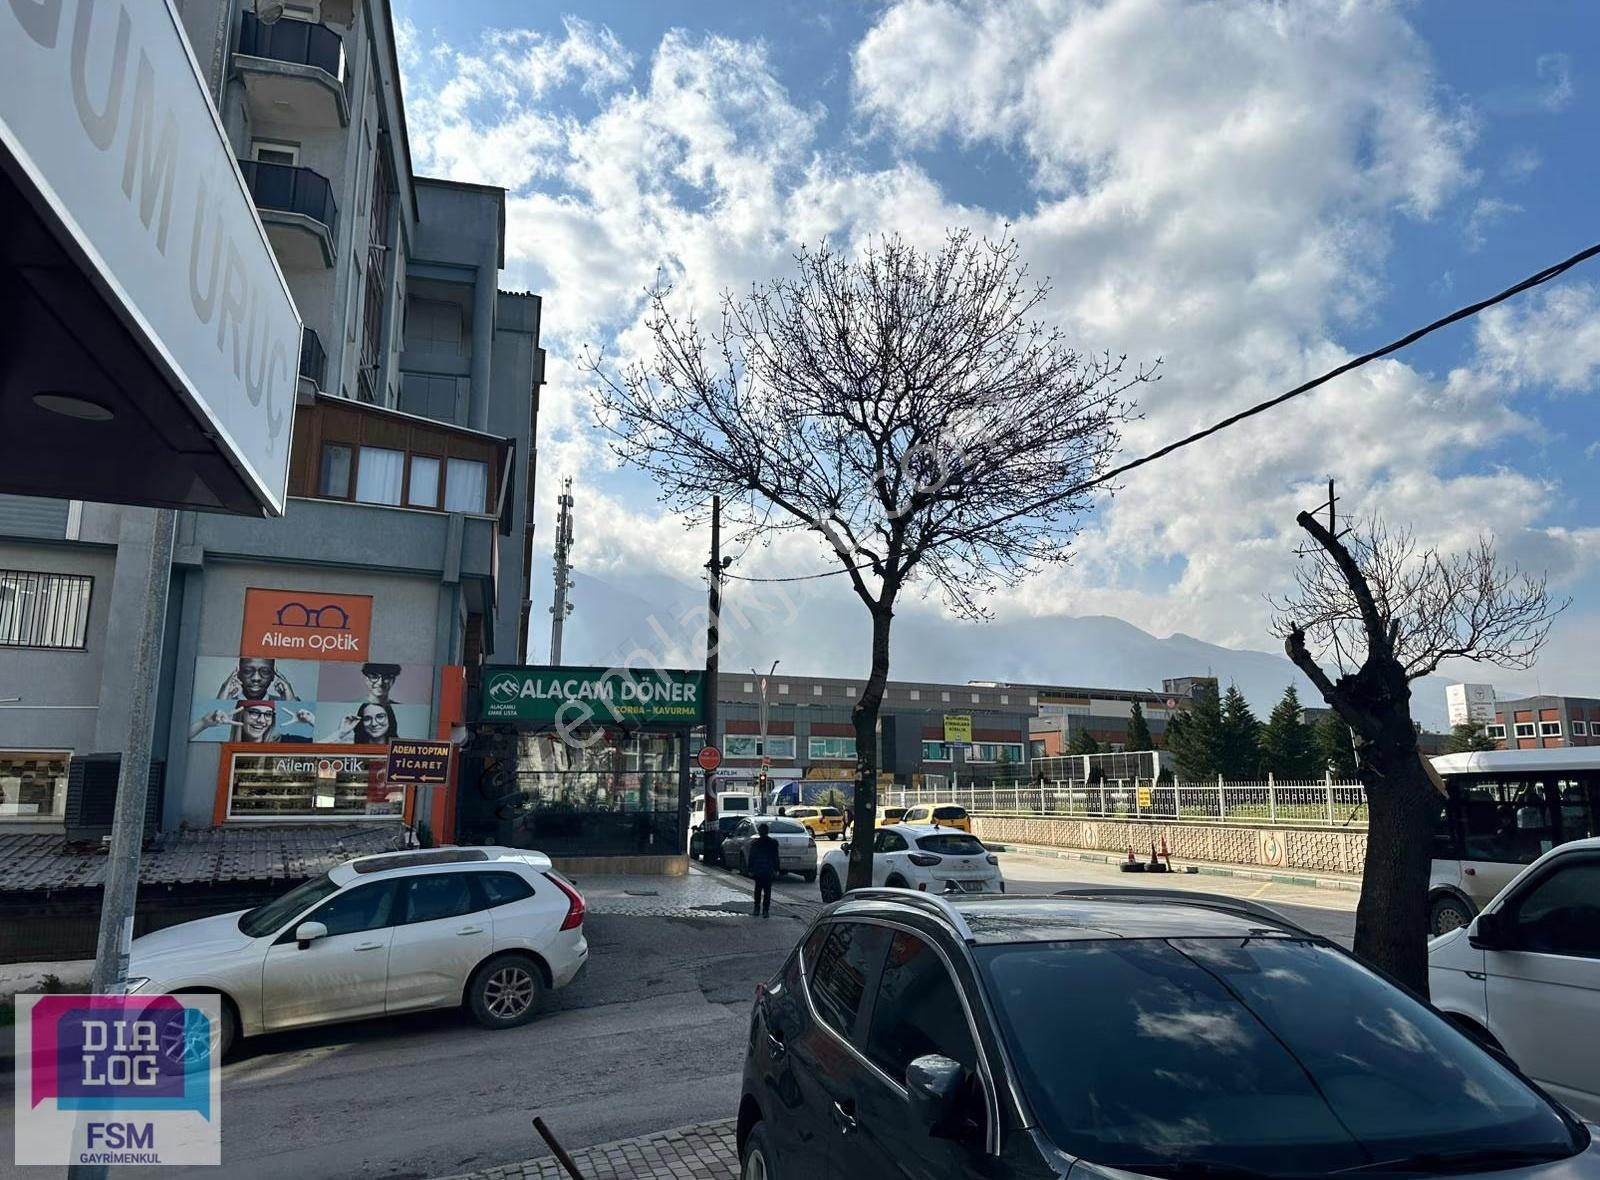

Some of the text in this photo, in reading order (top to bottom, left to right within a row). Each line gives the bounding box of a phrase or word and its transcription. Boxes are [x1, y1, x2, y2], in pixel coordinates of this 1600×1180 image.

[8, 0, 180, 256] UM
[262, 632, 304, 648] Ailem
[519, 675, 697, 703] ALAÇAM DÖNER
[653, 706, 696, 715] KAVURMA
[392, 745, 449, 757] ADEM TOPTAN
[276, 757, 315, 773] Ailem
[395, 757, 443, 770] TİCARET
